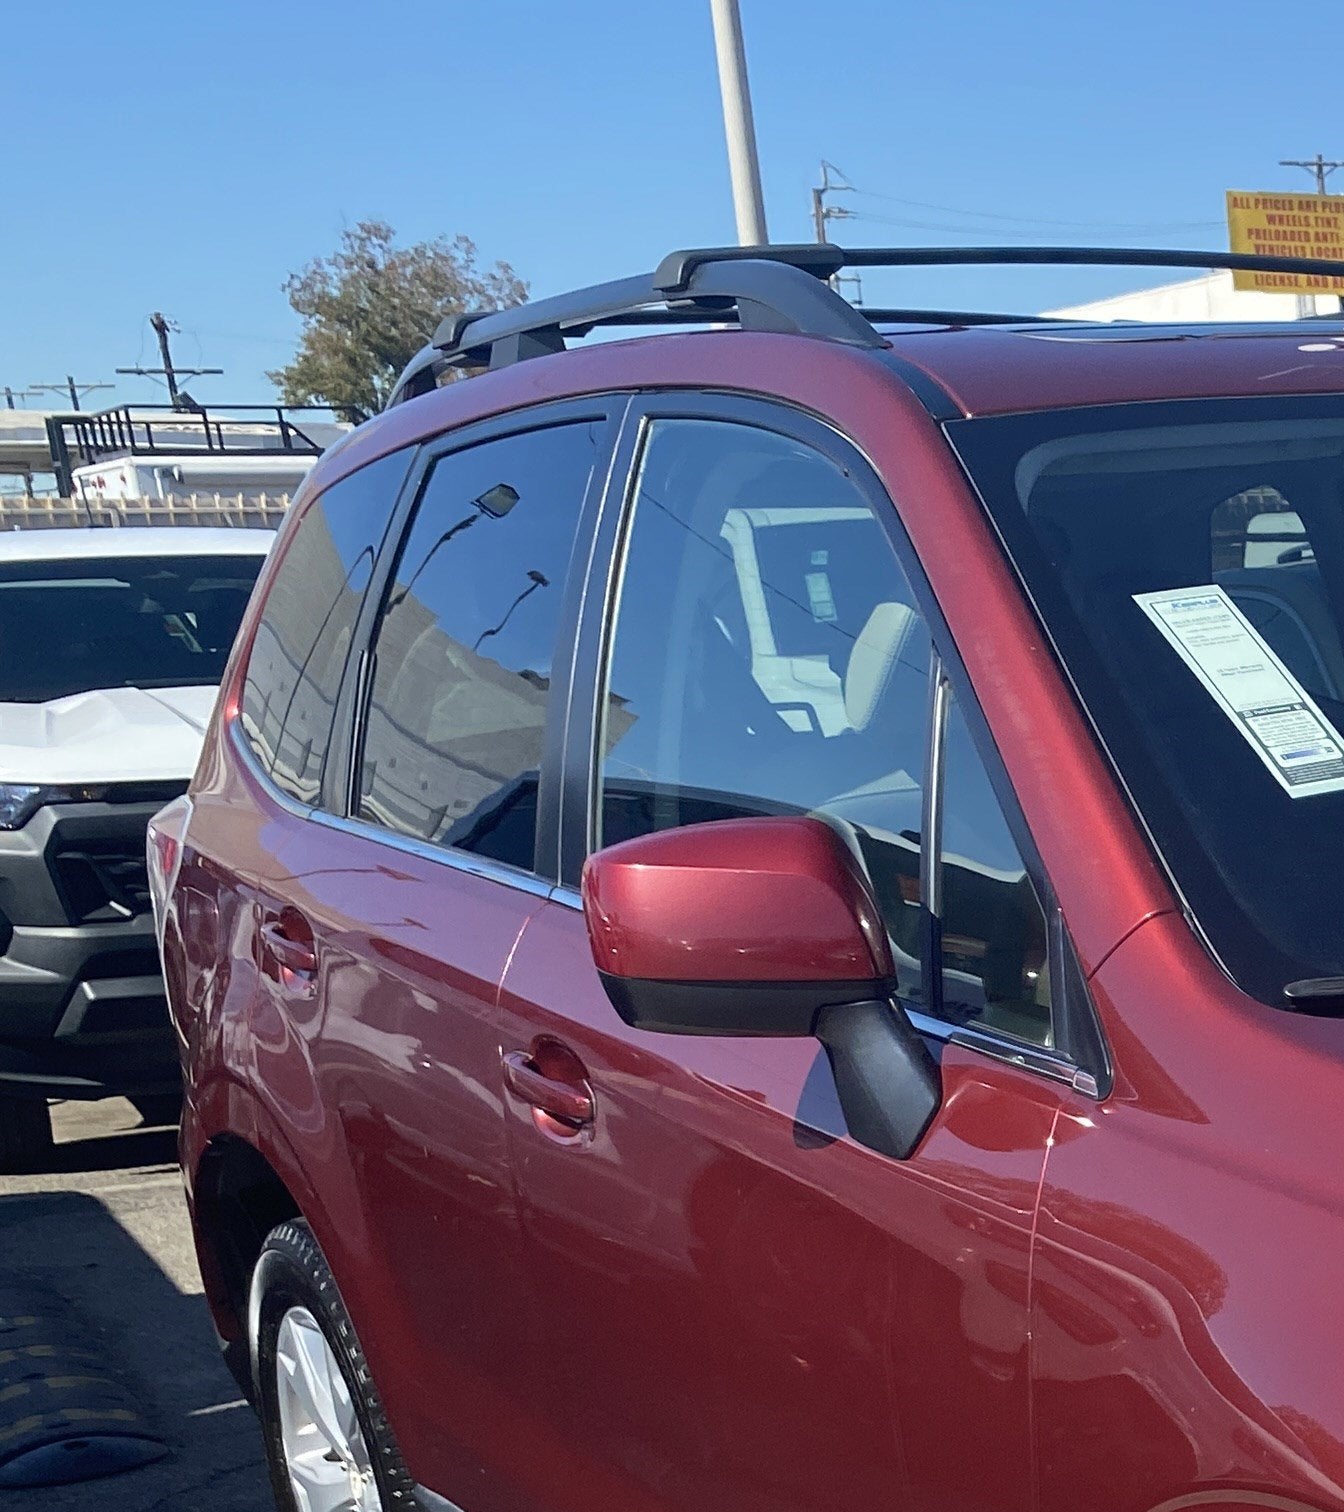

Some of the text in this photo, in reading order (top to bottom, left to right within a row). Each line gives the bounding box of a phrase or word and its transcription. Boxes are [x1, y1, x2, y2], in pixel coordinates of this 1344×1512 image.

[1233, 197, 1250, 209] ALL
[1255, 198, 1294, 211] PRICES
[1298, 200, 1318, 213] ARE
